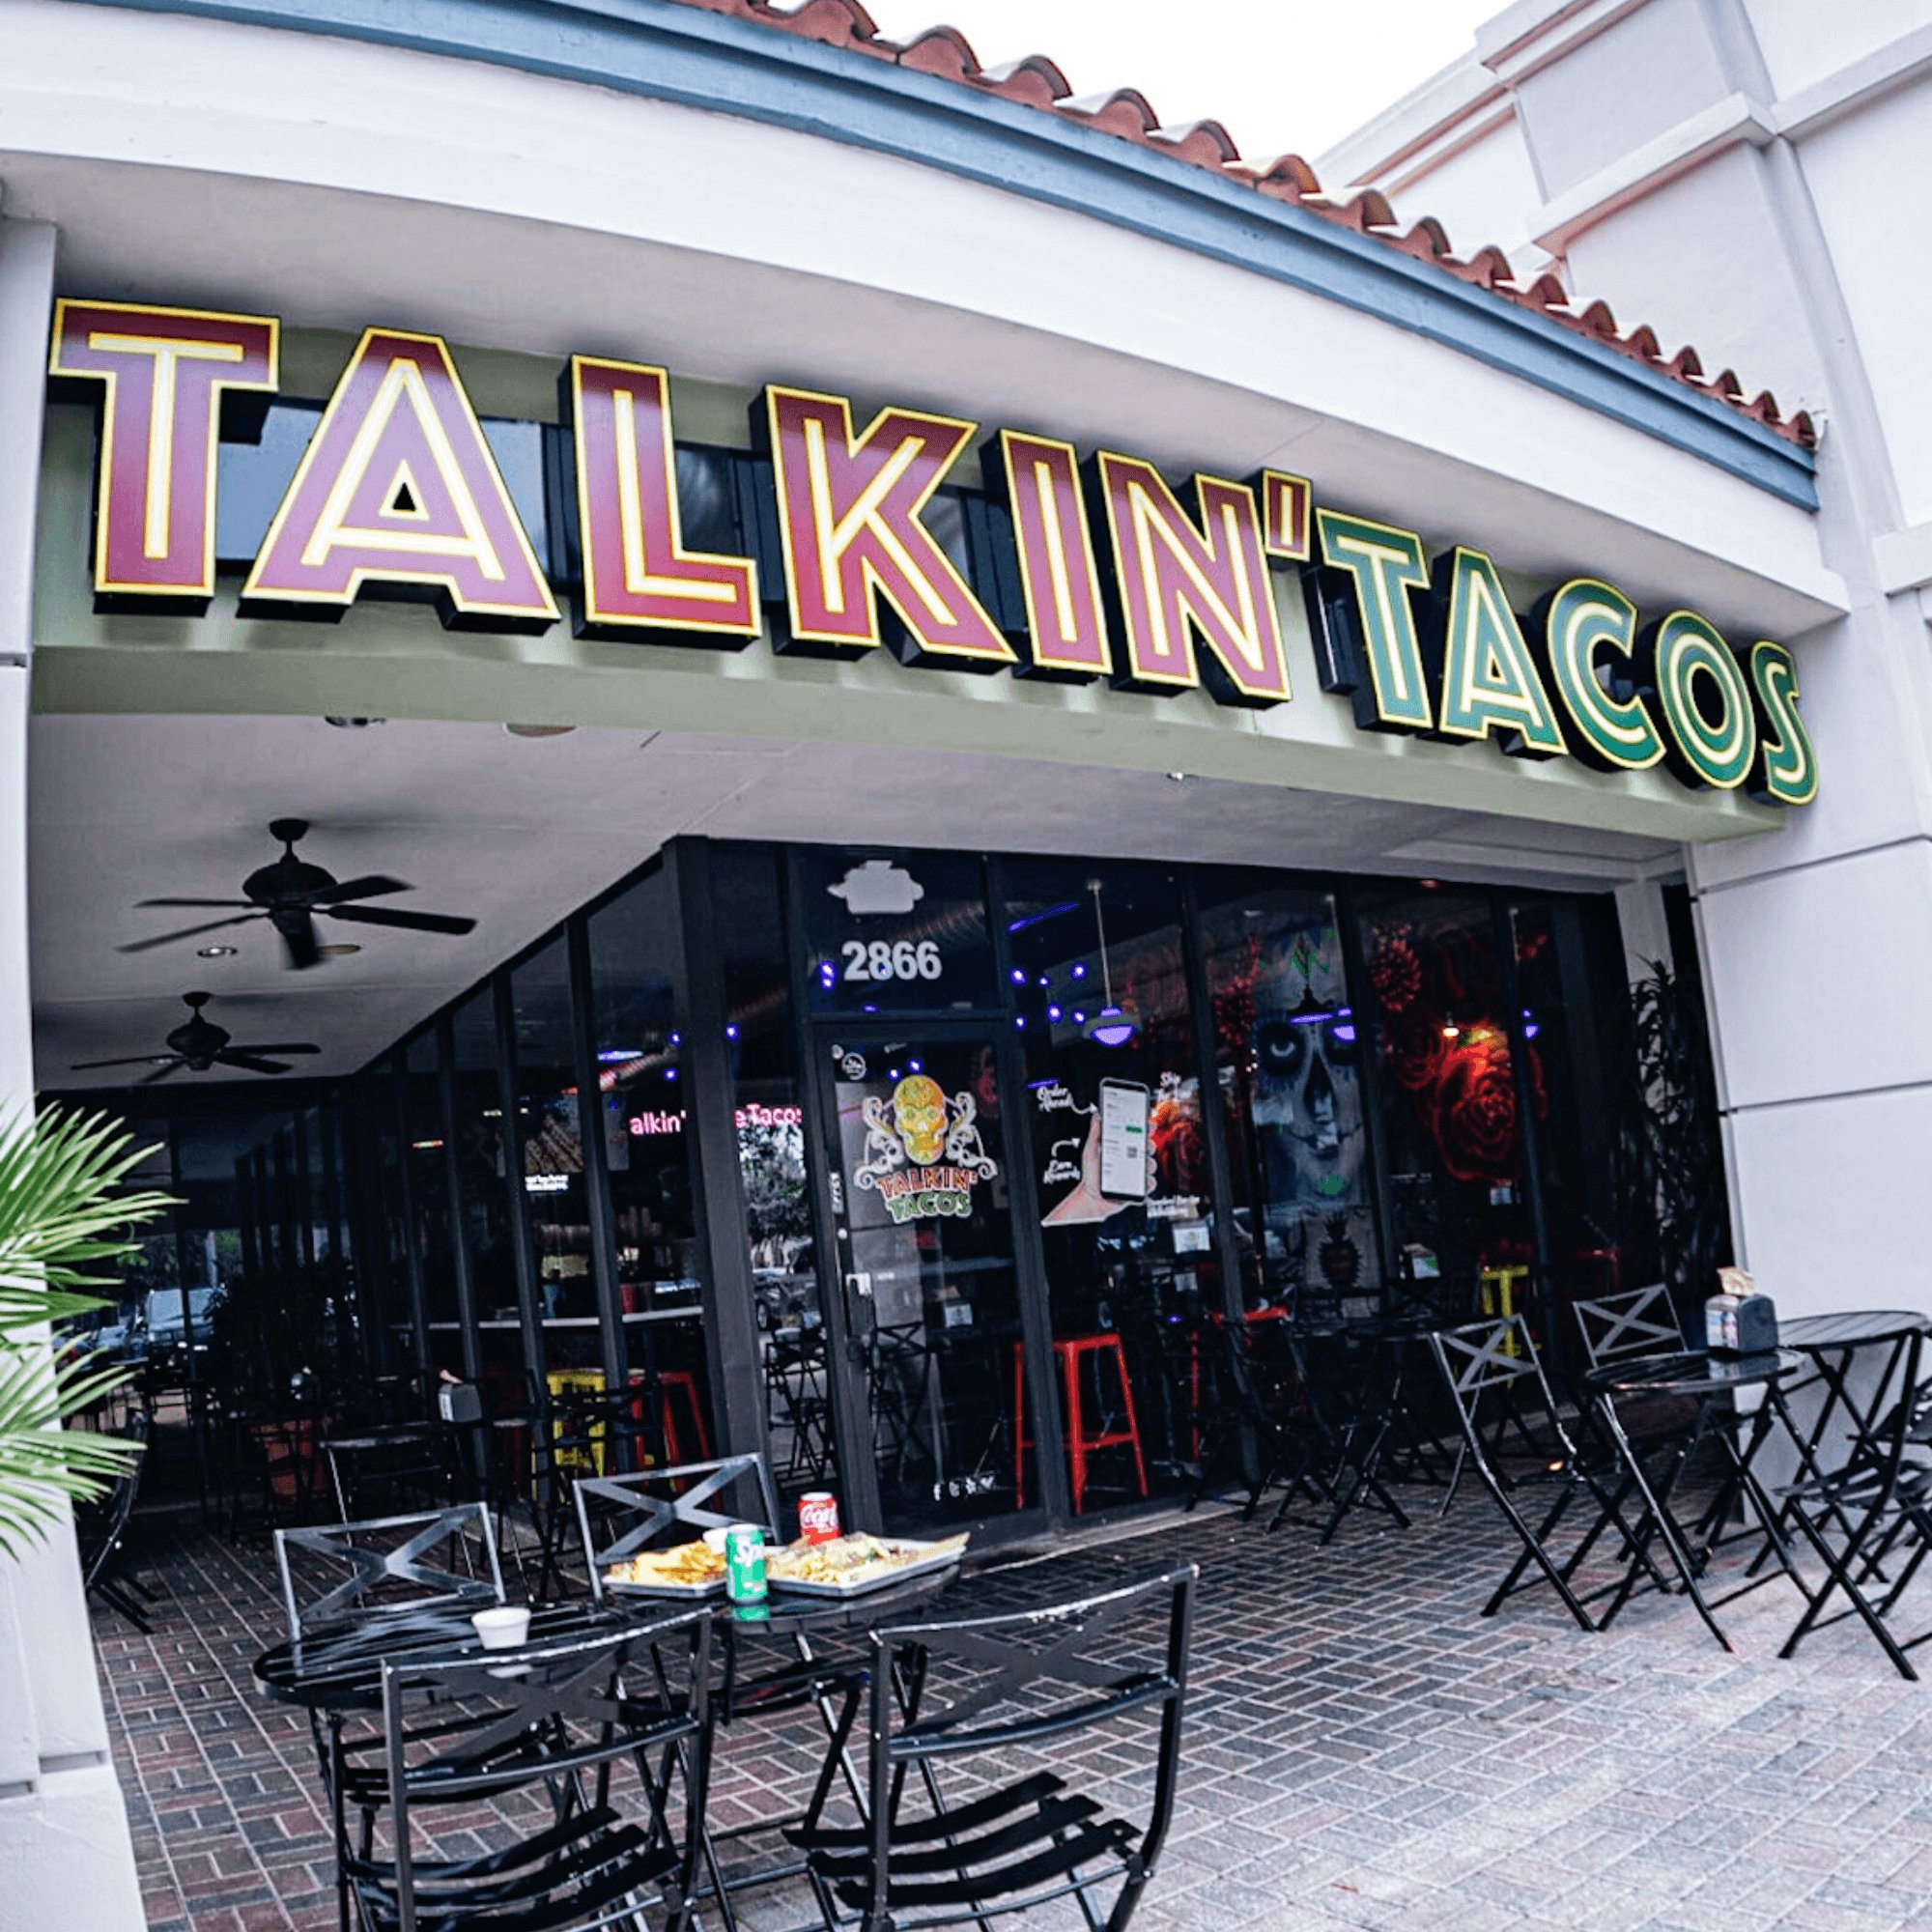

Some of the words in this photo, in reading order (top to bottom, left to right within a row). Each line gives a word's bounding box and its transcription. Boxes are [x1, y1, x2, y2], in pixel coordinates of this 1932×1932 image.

[48, 297, 1312, 701] TALKIN'
[1315, 507, 1818, 807] TACOS
[841, 940, 943, 980] 2866
[629, 1110, 687, 1135] alkin'
[874, 1166, 979, 1199] TALKIN'
[886, 1191, 973, 1224] TACOS
